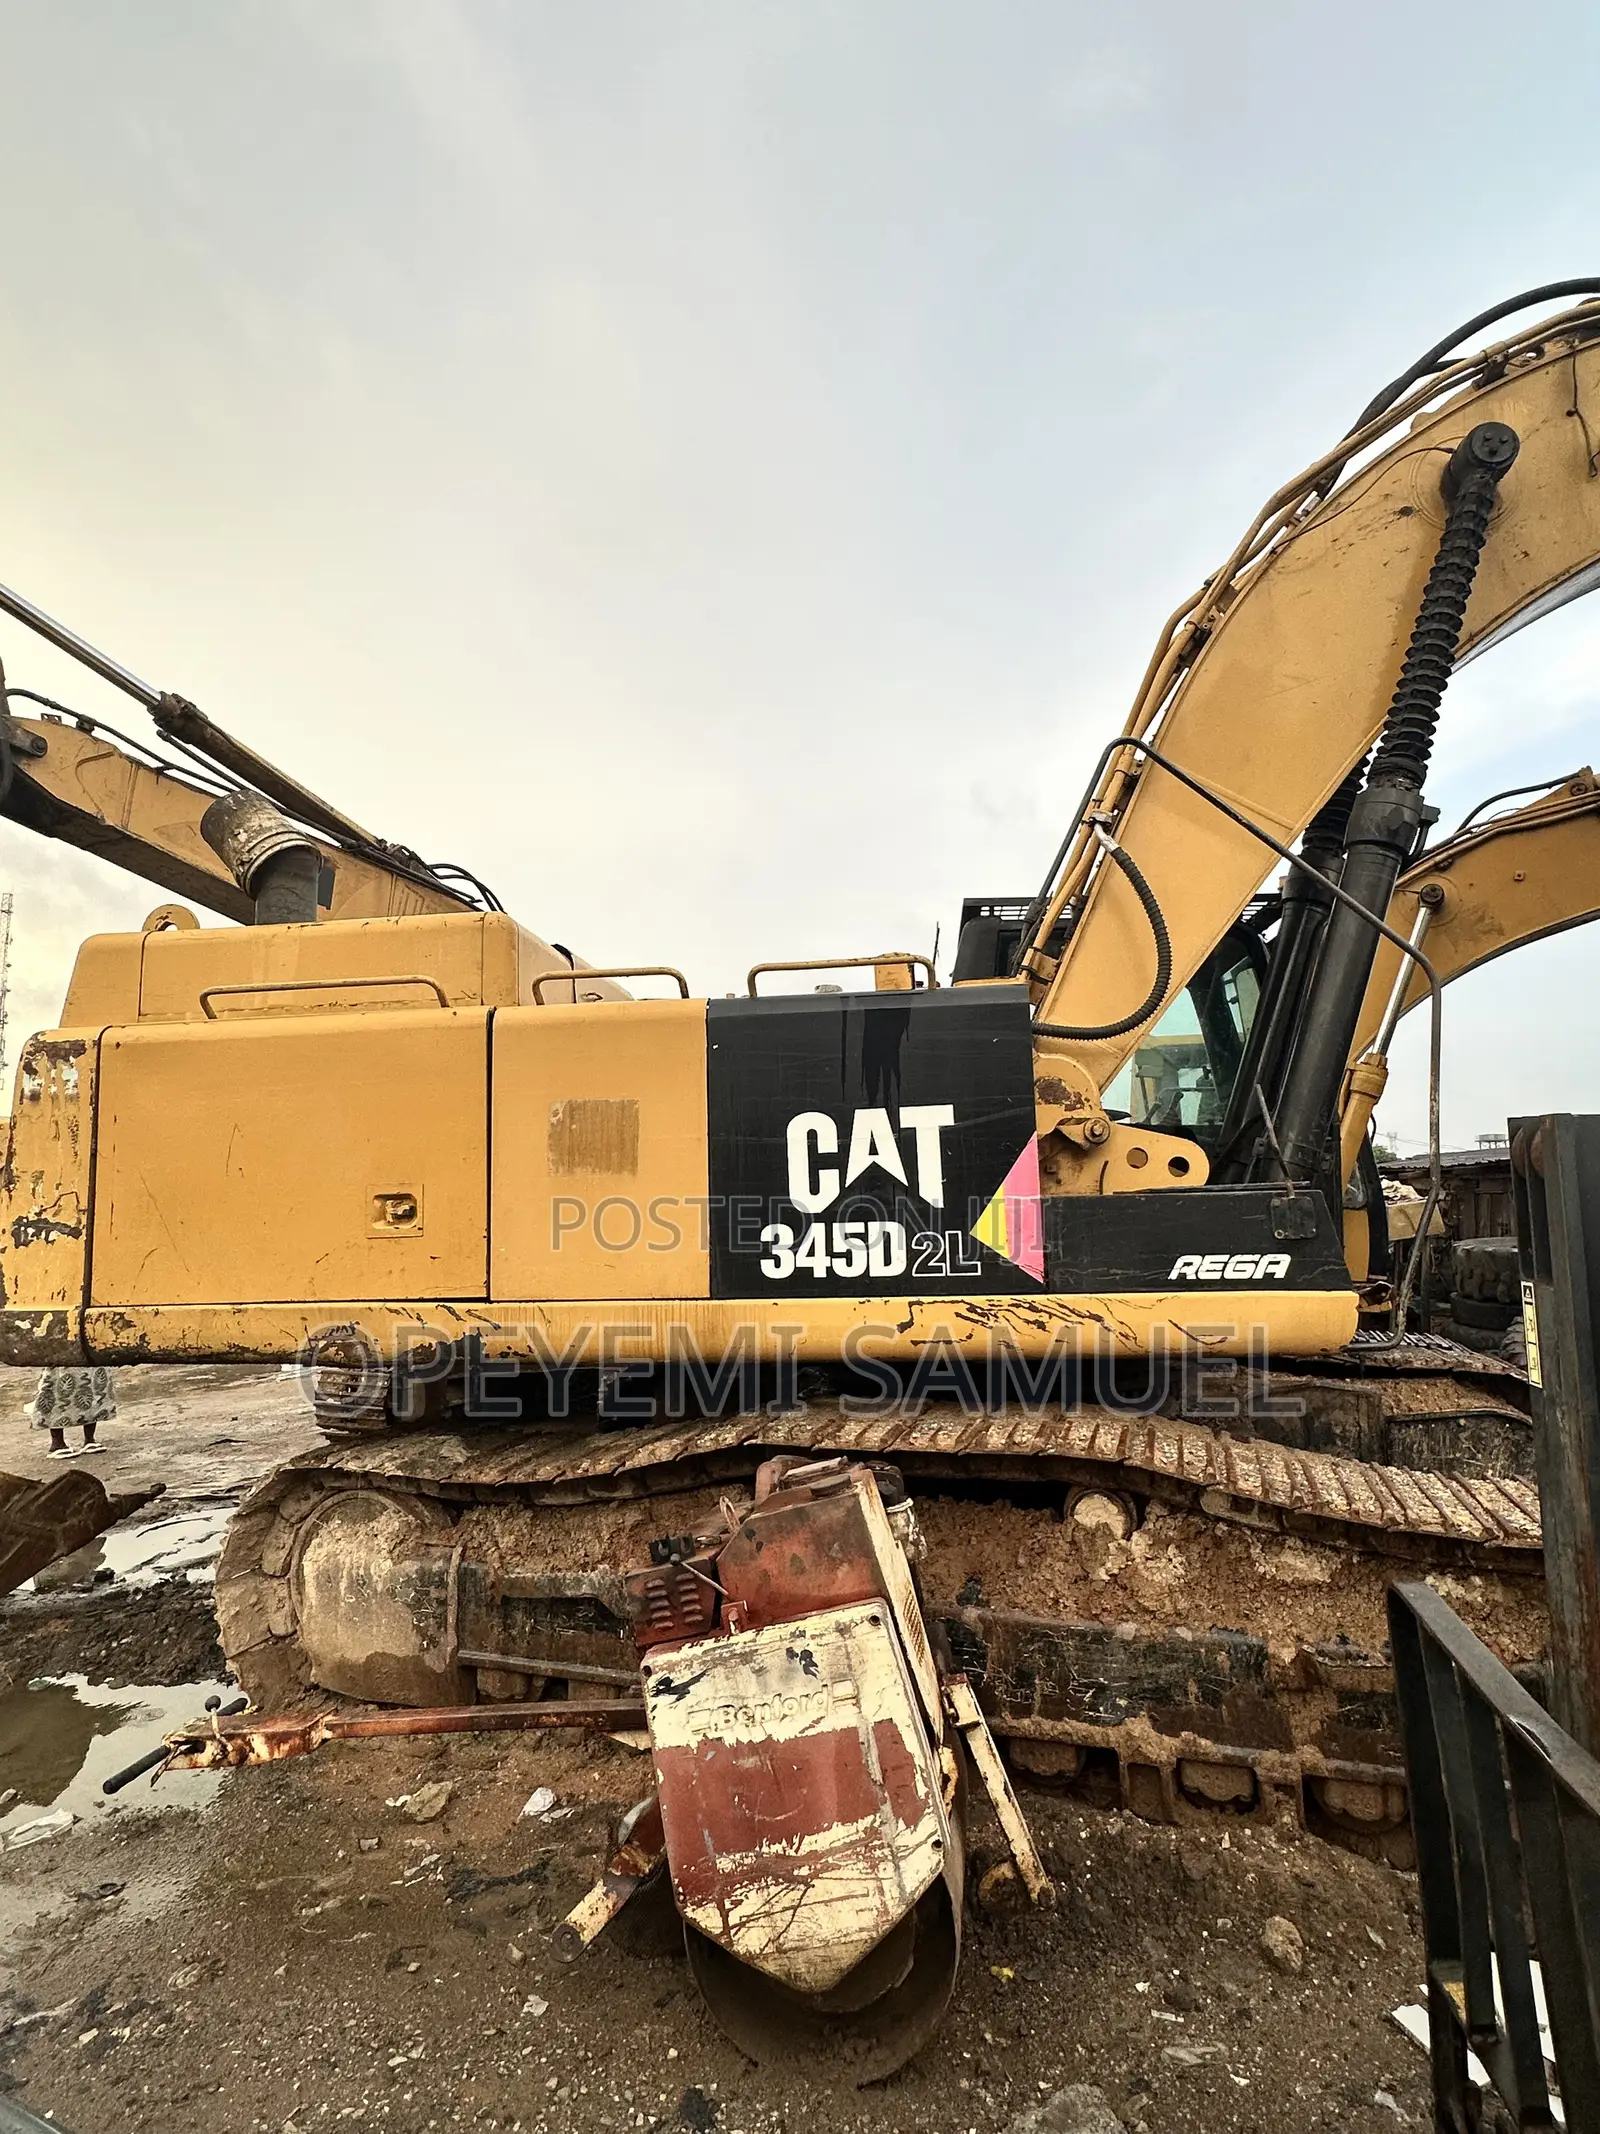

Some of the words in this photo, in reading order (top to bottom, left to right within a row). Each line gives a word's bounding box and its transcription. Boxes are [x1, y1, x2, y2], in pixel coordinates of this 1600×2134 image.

[785, 1104, 954, 1214] CAT
[760, 1221, 907, 1279] 345D
[911, 1231, 982, 1277] 2L
[1168, 1254, 1292, 1280] REGA
[711, 1684, 829, 1734] Benford
